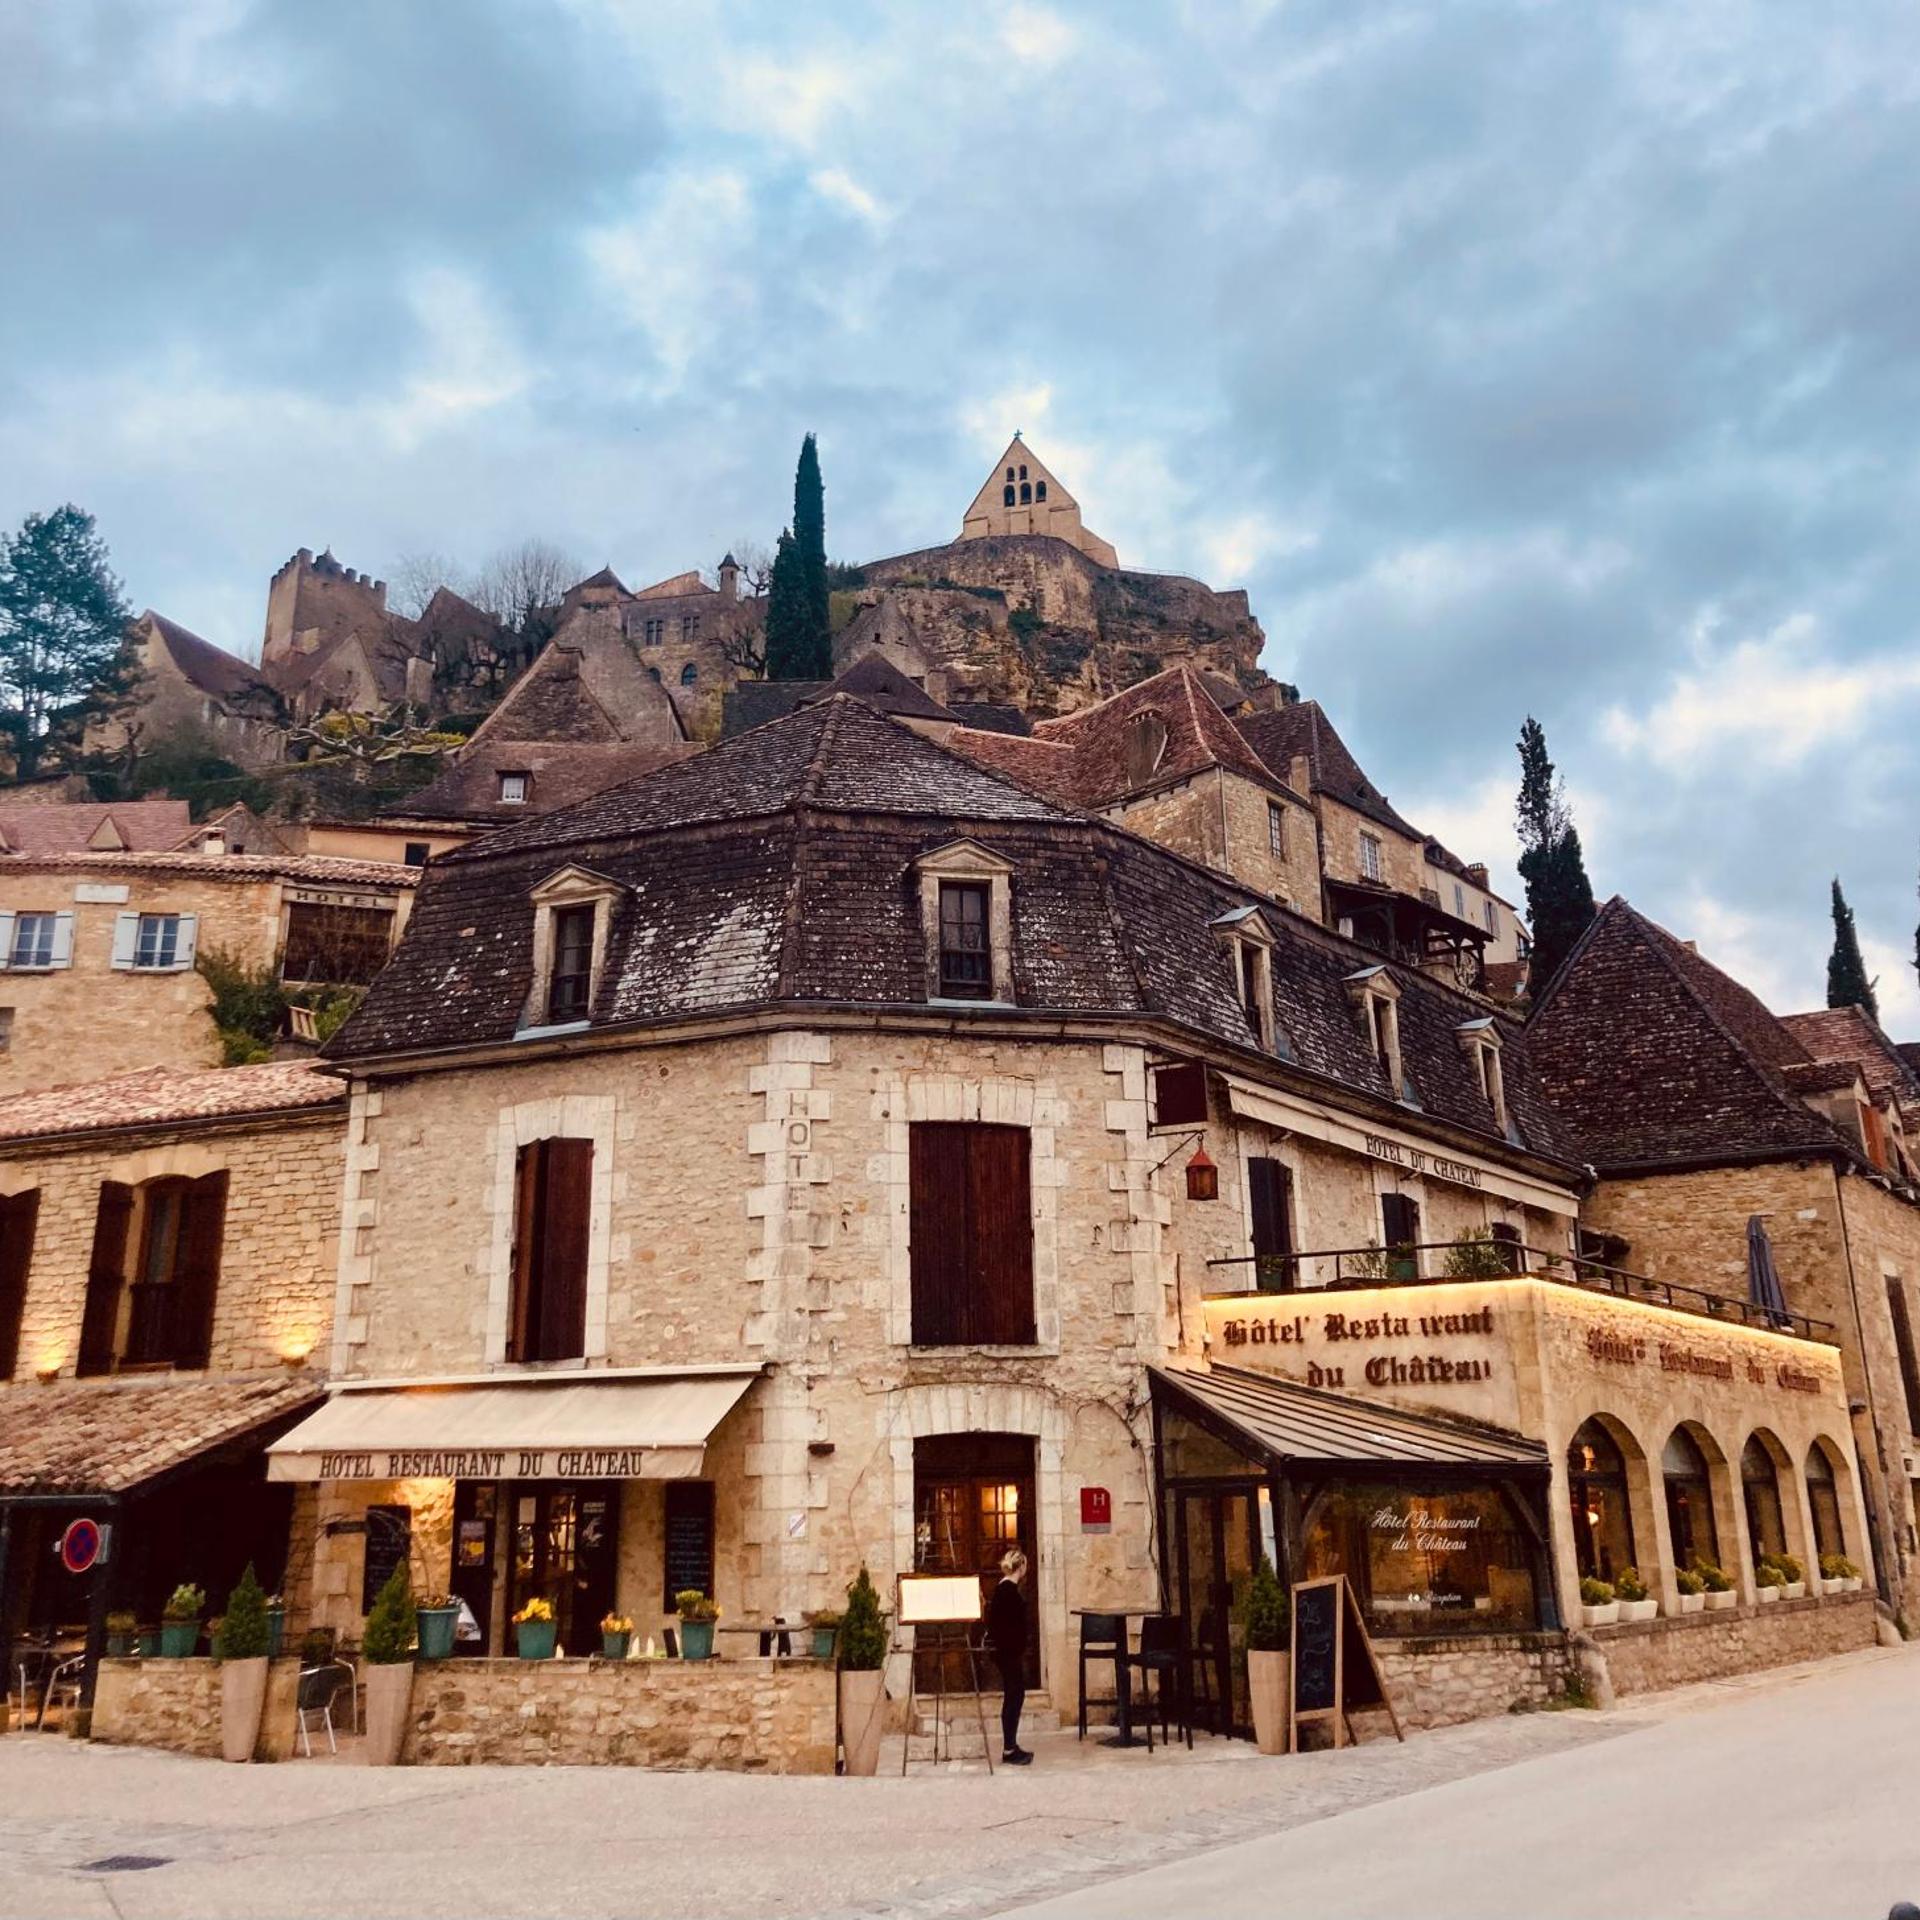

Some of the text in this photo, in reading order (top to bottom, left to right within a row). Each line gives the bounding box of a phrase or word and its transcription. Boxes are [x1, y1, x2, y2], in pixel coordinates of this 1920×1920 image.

[1365, 1134, 1481, 1188] HOTEL DU CHATEAU
[1306, 1360, 1346, 1388] du
[318, 1451, 644, 1479] HOTEL RESTAURANT DU CHATEAU
[1092, 1492, 1106, 1507] H
[1370, 1506, 1481, 1529] Hôtel Restaurant
[1391, 1531, 1467, 1551] du Château
